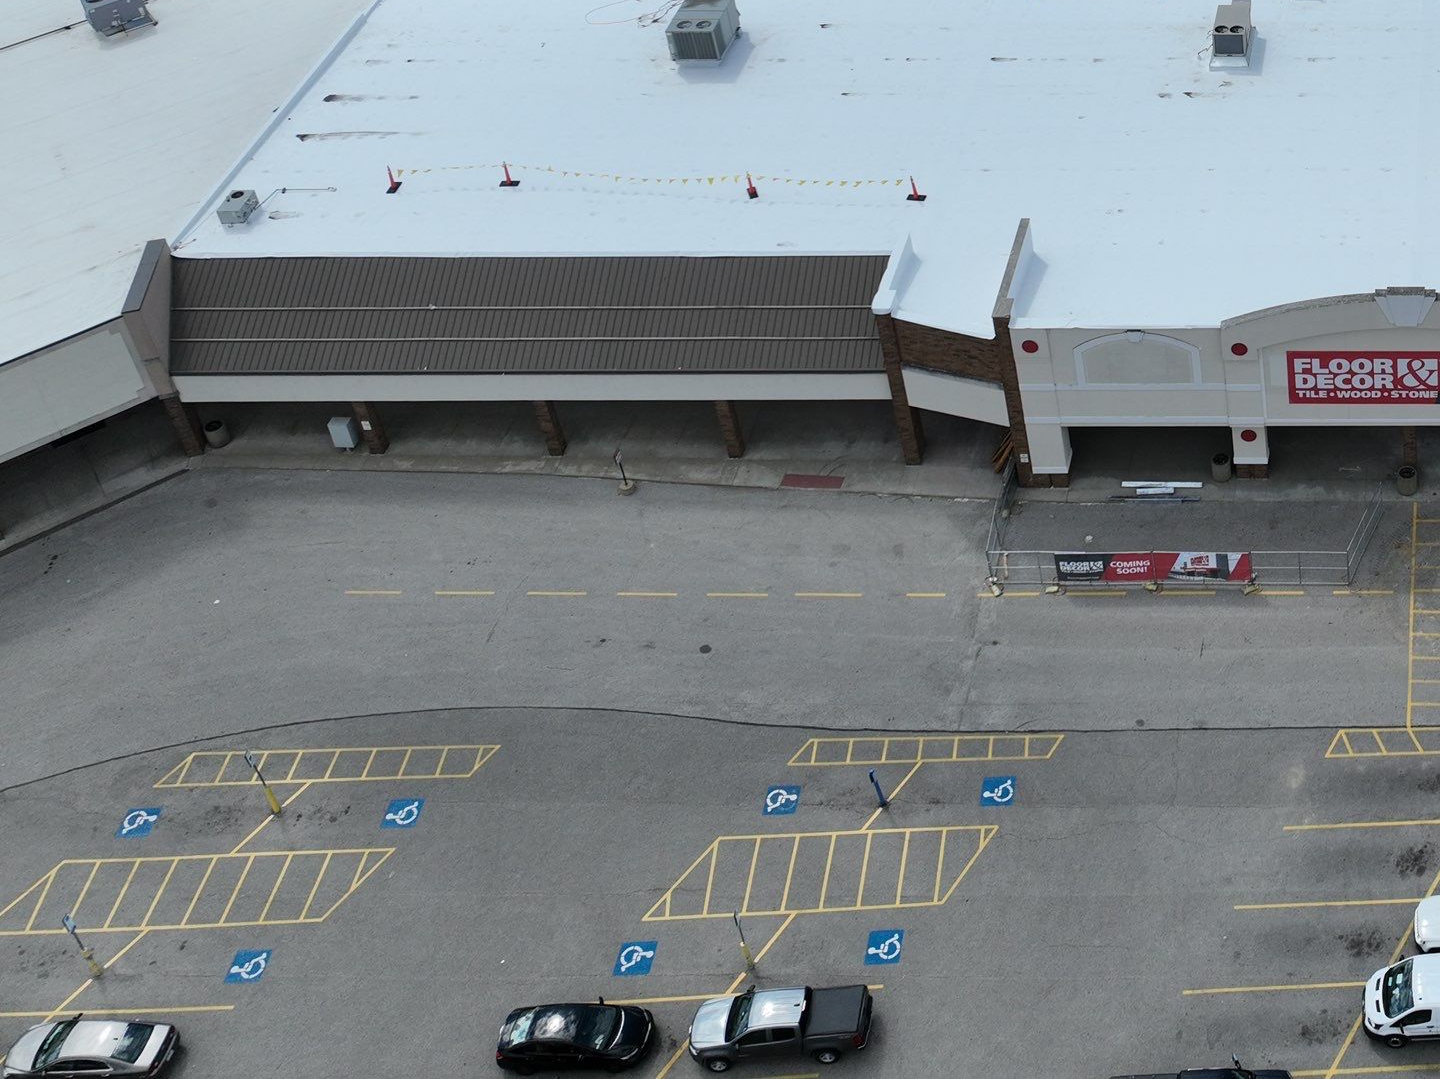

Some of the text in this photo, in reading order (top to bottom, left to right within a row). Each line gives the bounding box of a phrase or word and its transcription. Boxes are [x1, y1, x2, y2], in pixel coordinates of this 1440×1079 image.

[1293, 358, 1439, 389] FLOOR &
[1294, 373, 1394, 389] DECOR
[1295, 390, 1439, 398] TILE WOOD STONE
[1109, 559, 1151, 568] COMING
[1116, 566, 1148, 575] SOON!
